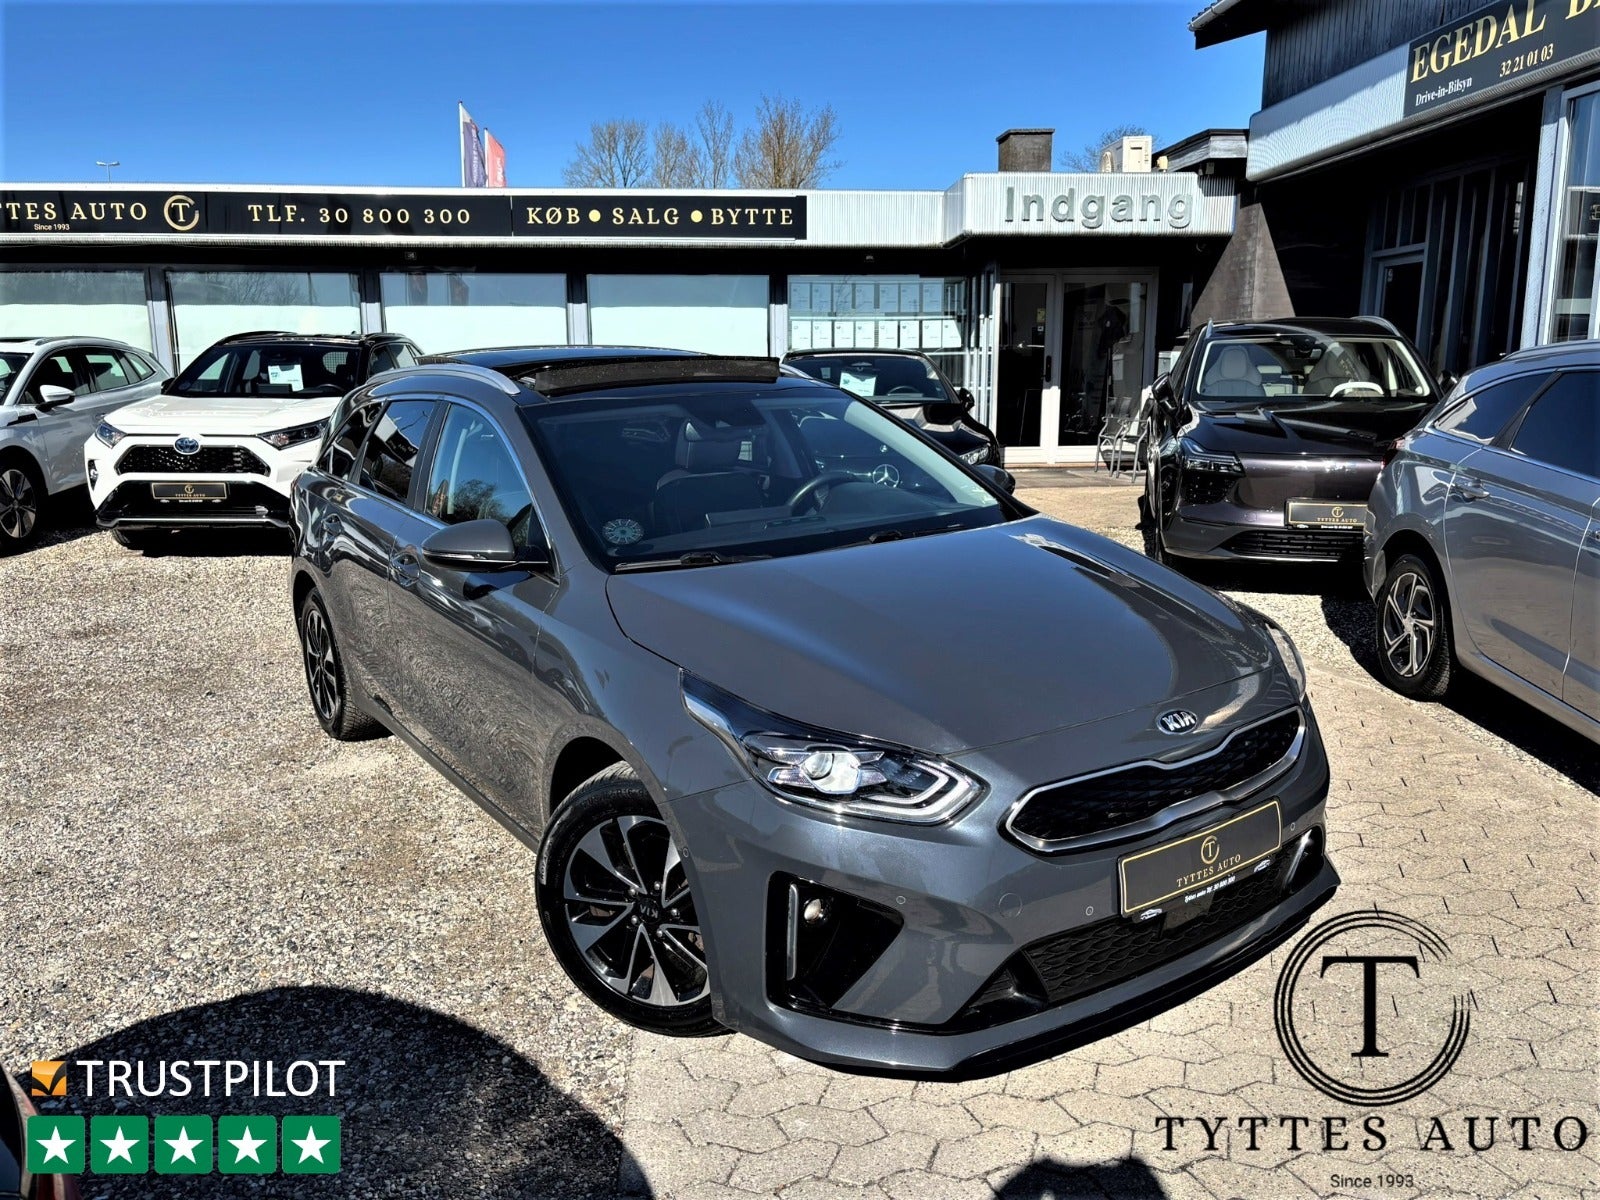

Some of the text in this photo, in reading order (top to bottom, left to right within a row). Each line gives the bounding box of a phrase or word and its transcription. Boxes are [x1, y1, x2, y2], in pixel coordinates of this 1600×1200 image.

[1410, 0, 1546, 83] EGEDAL
[1499, 43, 1554, 77] 32 21 01 03
[1415, 76, 1473, 107] Drive-in-Bilsyn
[0, 202, 147, 221] TES AUTO
[247, 204, 471, 224] TLF. 30 800 300
[526, 206, 793, 226] KØB SALG BYTTE
[1004, 186, 1194, 229] Indgang
[33, 223, 70, 231] Since 1993
[1161, 713, 1196, 732] KIA
[1176, 854, 1241, 888] TYTTES AUTO
[640, 904, 659, 919] KIA
